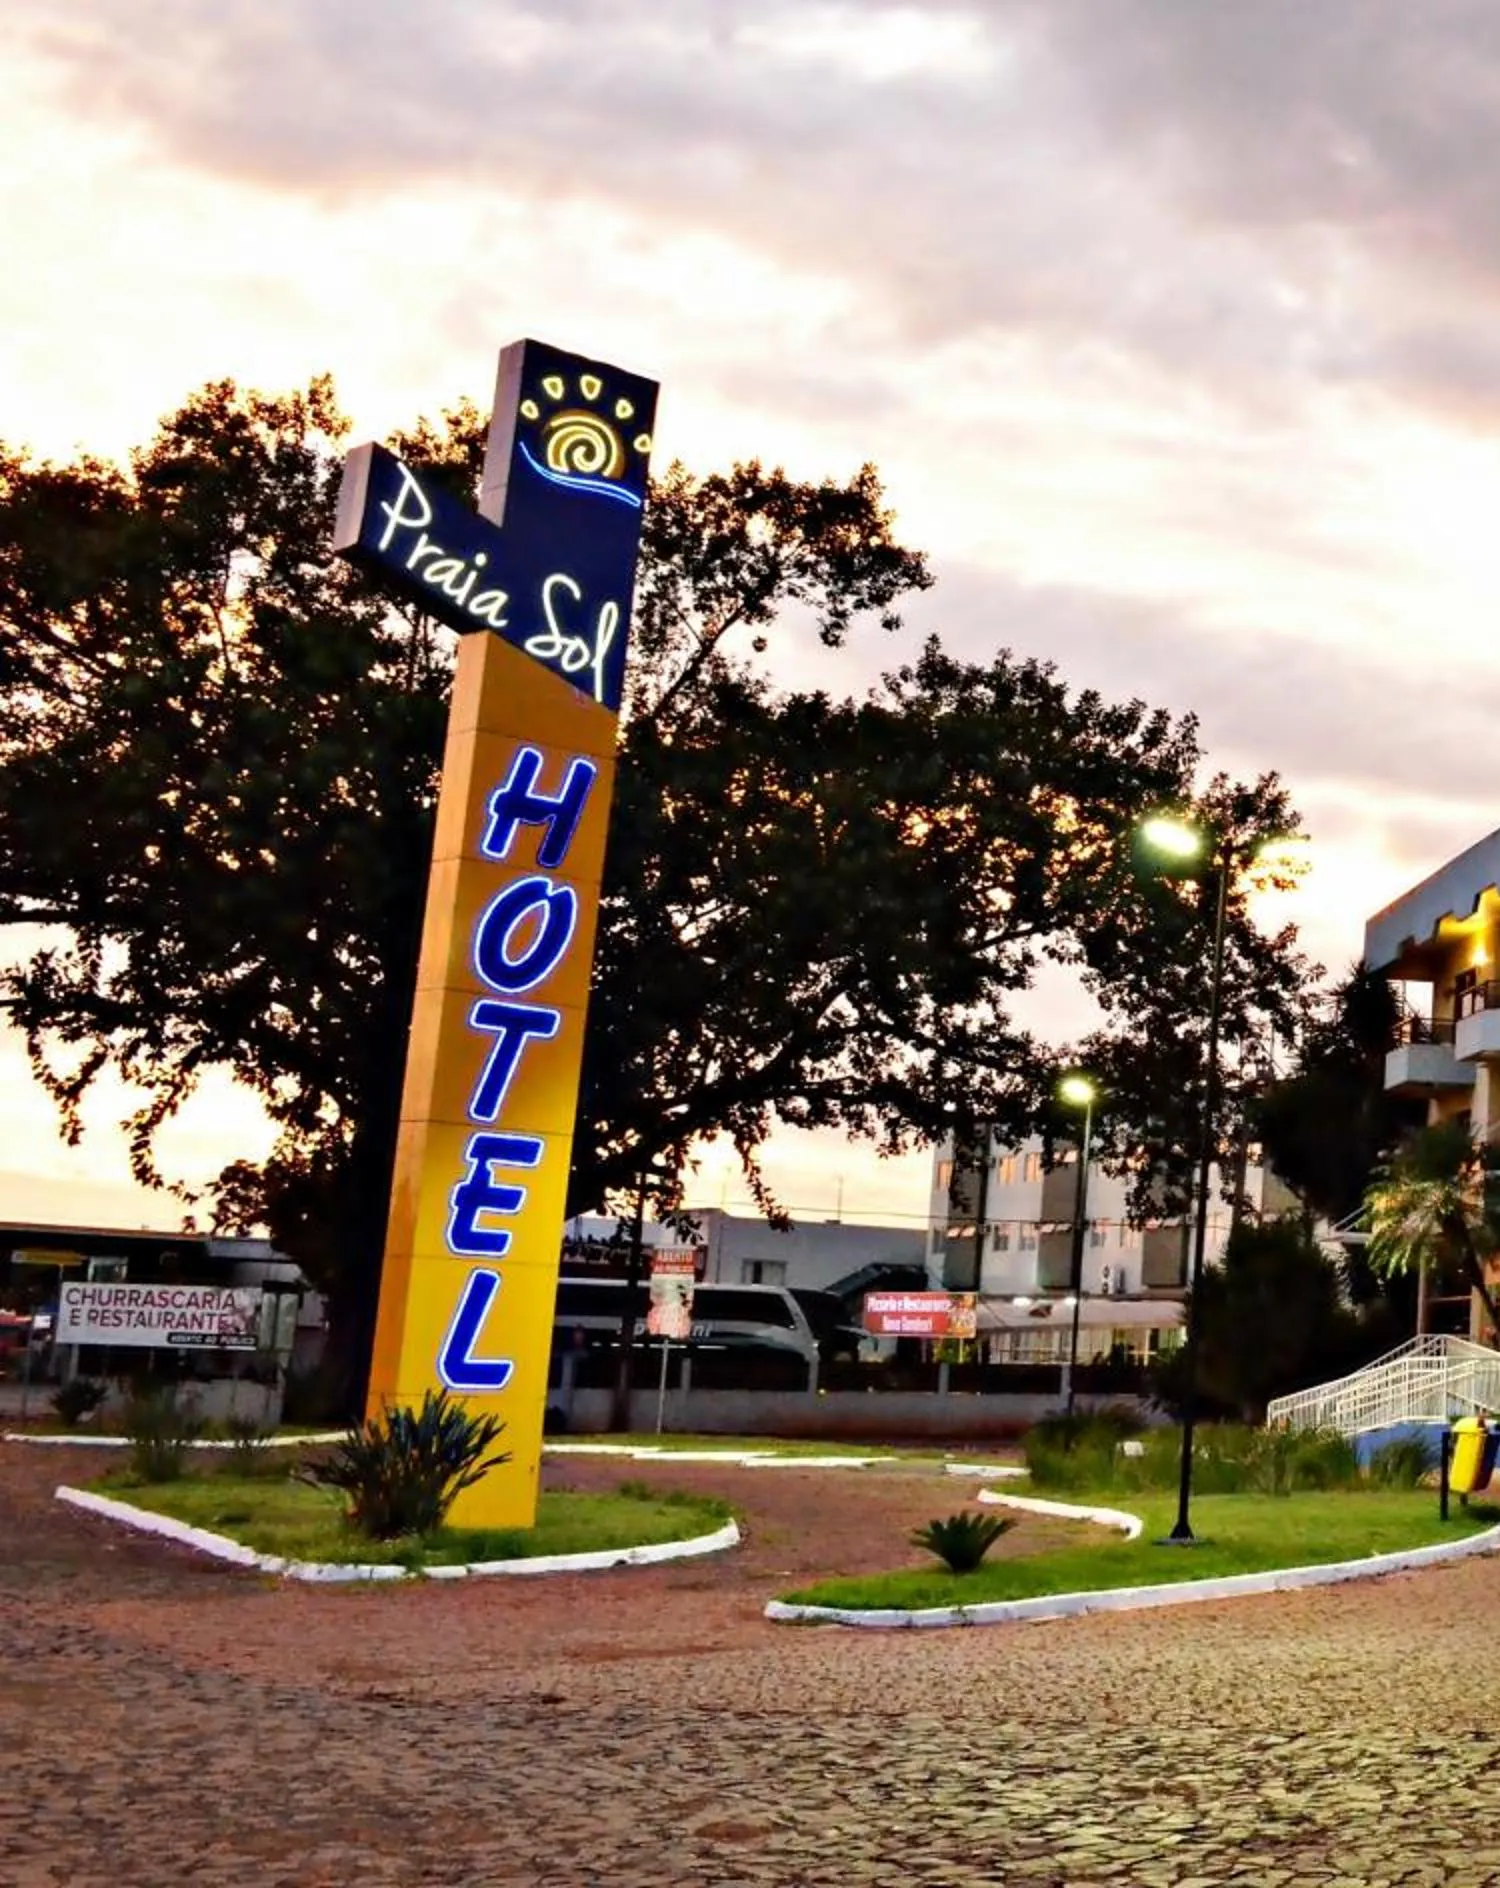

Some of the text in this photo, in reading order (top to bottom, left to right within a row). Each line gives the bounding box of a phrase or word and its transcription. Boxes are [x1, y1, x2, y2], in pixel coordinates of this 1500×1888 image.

[378, 460, 619, 703] Praia Sol
[438, 746, 597, 1390] HOTEL
[65, 1287, 236, 1311] CHURRASCARIA
[69, 1308, 230, 1332] E RESTAURANTE
